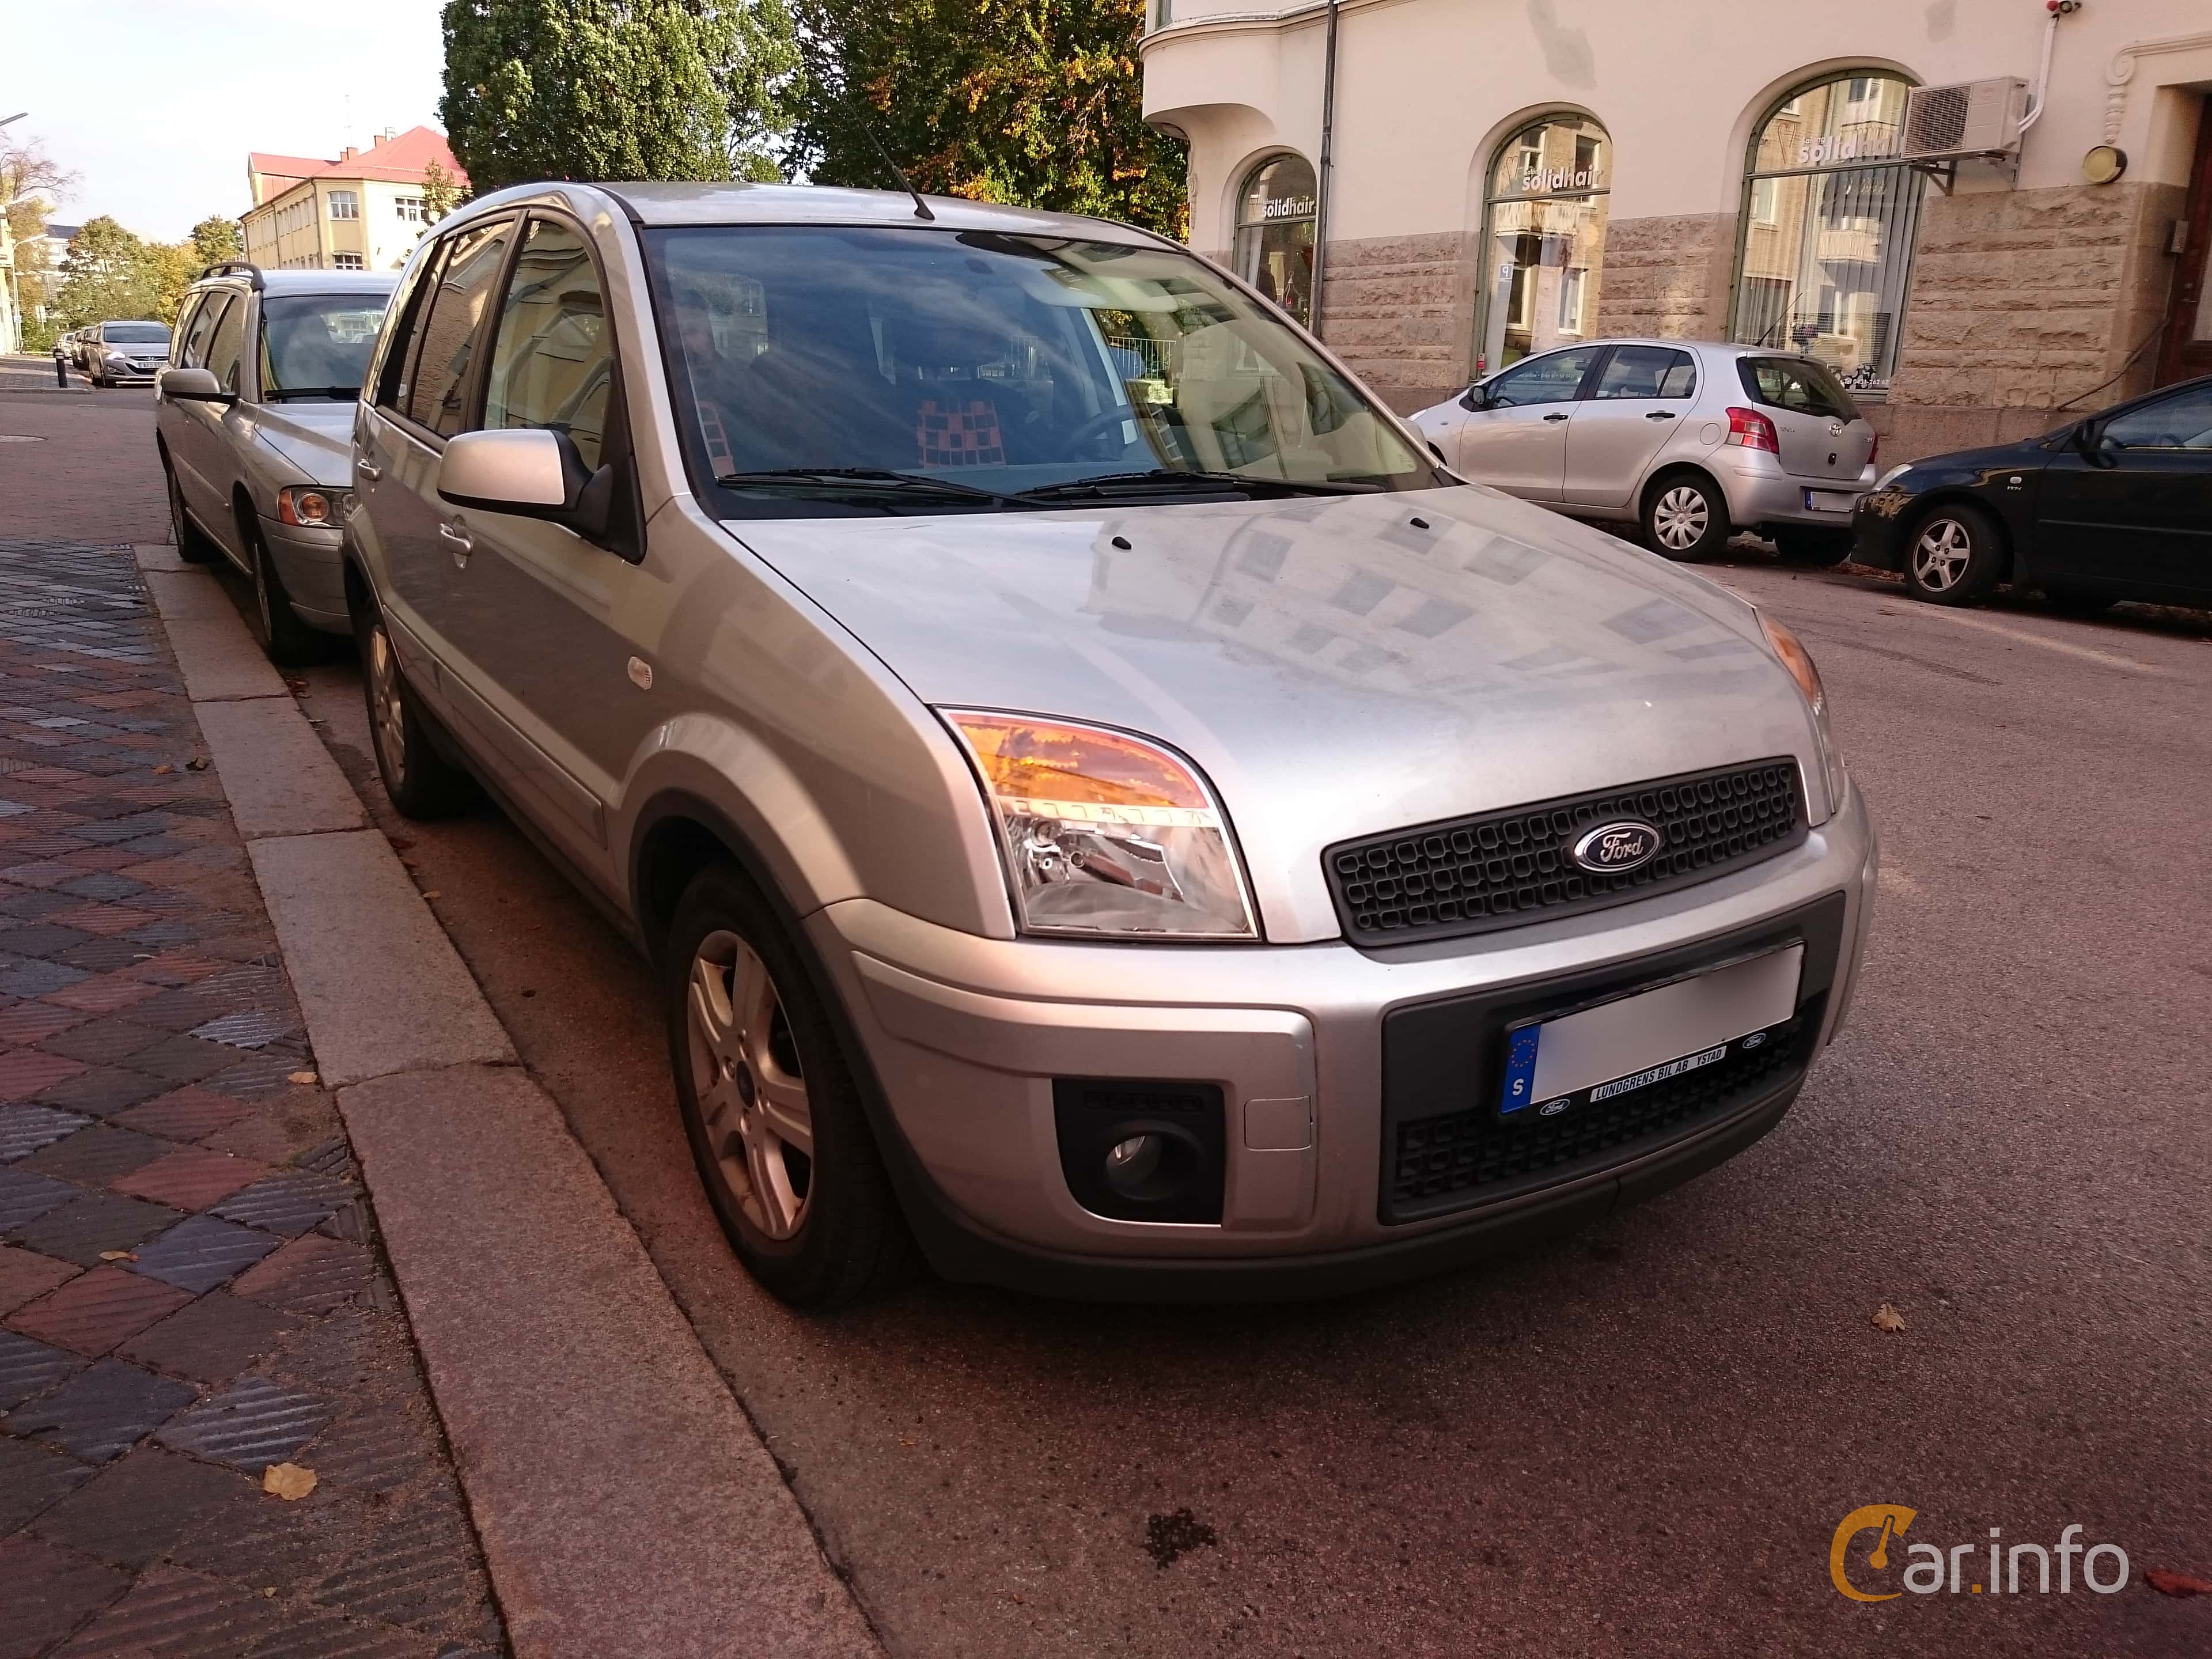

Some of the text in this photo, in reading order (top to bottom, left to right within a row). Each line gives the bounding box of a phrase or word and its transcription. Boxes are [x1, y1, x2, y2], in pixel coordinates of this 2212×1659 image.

[1797, 128, 1903, 163] solidhai
[1522, 164, 1603, 191] solidhair
[1262, 196, 1315, 217] solidhair
[1600, 832, 1643, 862] Ford
[1512, 1078, 1524, 1096] S
[1596, 1049, 1722, 1100] LUNDGRENS BIL AB YSTAD
